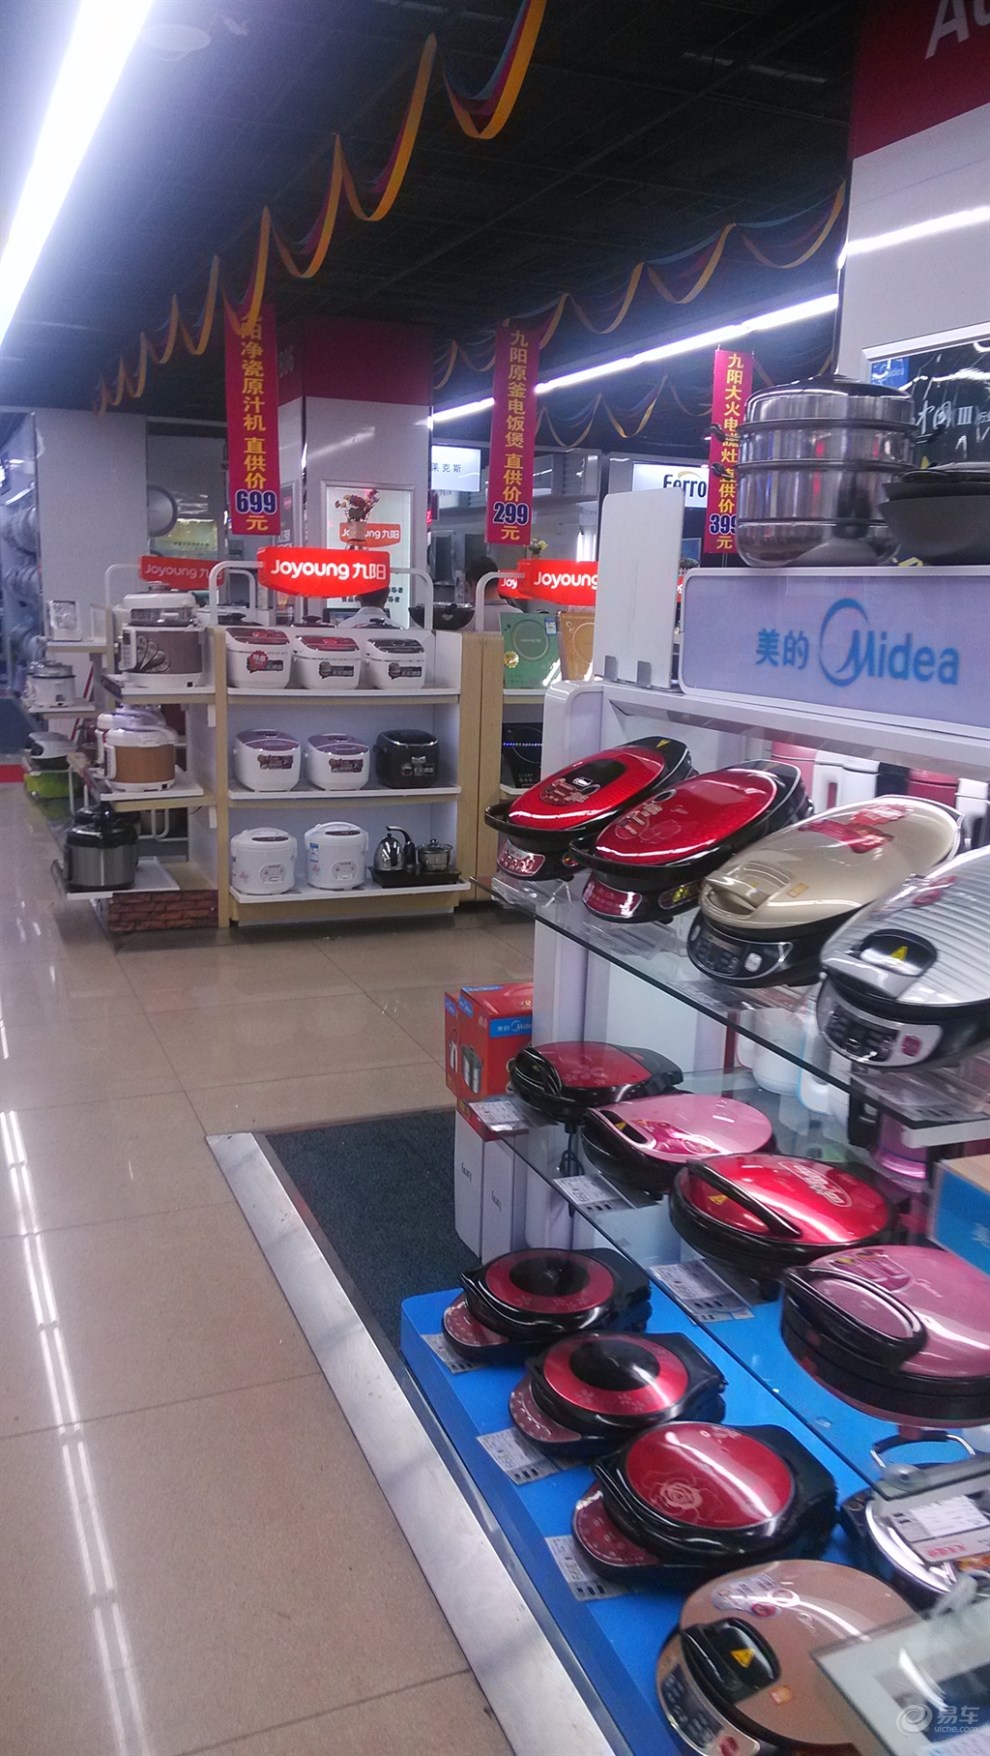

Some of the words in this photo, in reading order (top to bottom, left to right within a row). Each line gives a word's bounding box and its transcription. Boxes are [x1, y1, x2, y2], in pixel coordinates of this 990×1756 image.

[505, 330, 528, 448] 九阳原釜电饭煲
[244, 437, 266, 489] 直供价
[502, 453, 524, 502] 直供价
[235, 488, 278, 515] 699
[245, 515, 269, 531] 元
[492, 501, 529, 526] 299
[501, 525, 520, 540] 元
[716, 535, 733, 549] 元
[144, 564, 198, 579] Joyoung
[270, 559, 350, 580] Joyoung
[352, 562, 387, 580] 九阳
[533, 571, 598, 589] Joyoung
[755, 628, 810, 670] 美的
[818, 597, 960, 686] Midea
